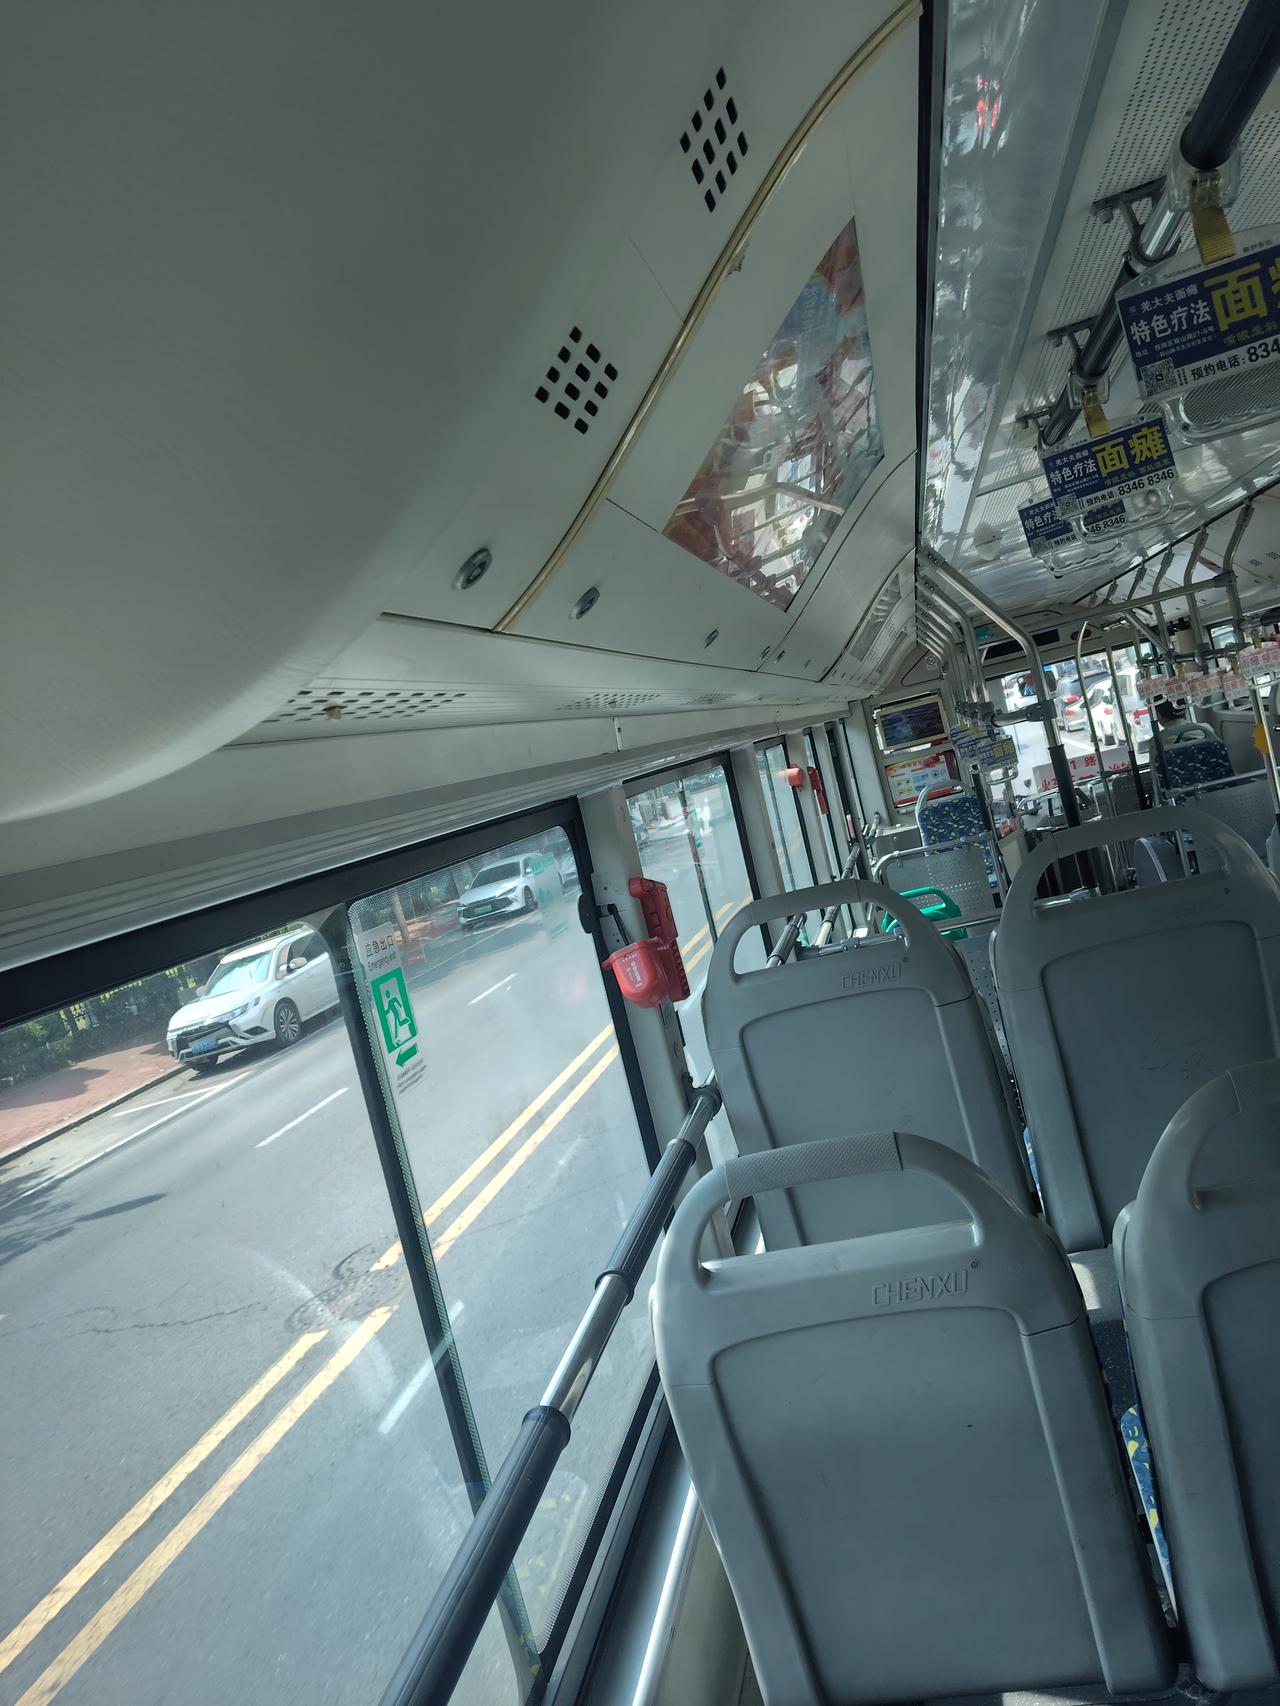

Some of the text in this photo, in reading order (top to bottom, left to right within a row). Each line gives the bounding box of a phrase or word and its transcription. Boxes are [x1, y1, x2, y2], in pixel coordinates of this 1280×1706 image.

[1203, 257, 1280, 332] 面
[1130, 299, 1212, 345] 特色疗法
[1091, 426, 1168, 477] 面瘫
[1049, 459, 1098, 485] 特色疗法
[1118, 479, 1145, 496] 8346
[1147, 468, 1175, 486] 8346
[1103, 515, 1126, 529] 8346
[871, 1270, 969, 1305] CHENXU
